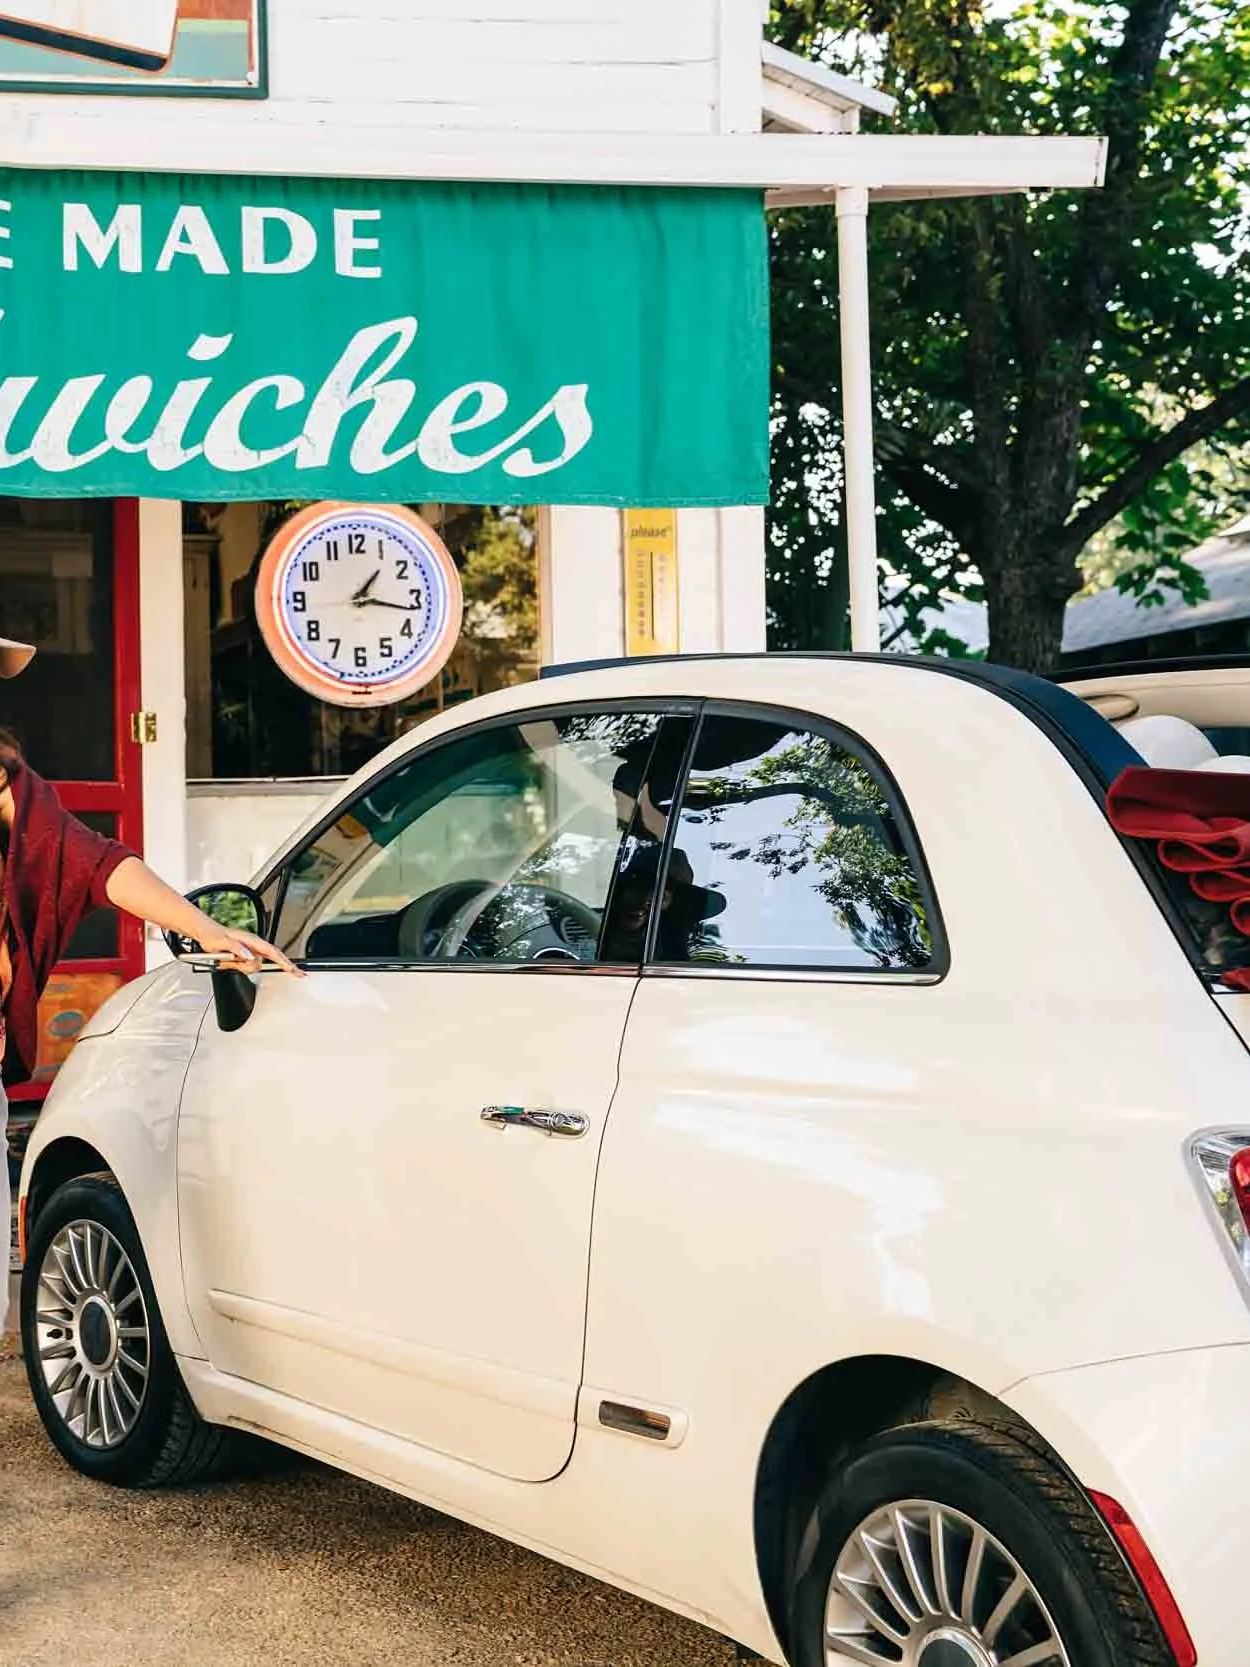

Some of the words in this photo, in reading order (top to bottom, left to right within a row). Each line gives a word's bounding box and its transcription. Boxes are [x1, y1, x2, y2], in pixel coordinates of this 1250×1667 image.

[64, 203, 381, 277] MADE
[326, 541, 338, 561] 11
[349, 534, 366, 554] 12
[378, 539, 384, 560] 1
[302, 561, 319, 581] 10
[395, 560, 408, 580] 2
[293, 591, 306, 612] 9
[409, 589, 422, 610] 3
[307, 620, 320, 641] 8
[400, 618, 413, 639] 4
[328, 638, 341, 659] 7
[354, 647, 367, 667] 6
[379, 637, 392, 658] 5
